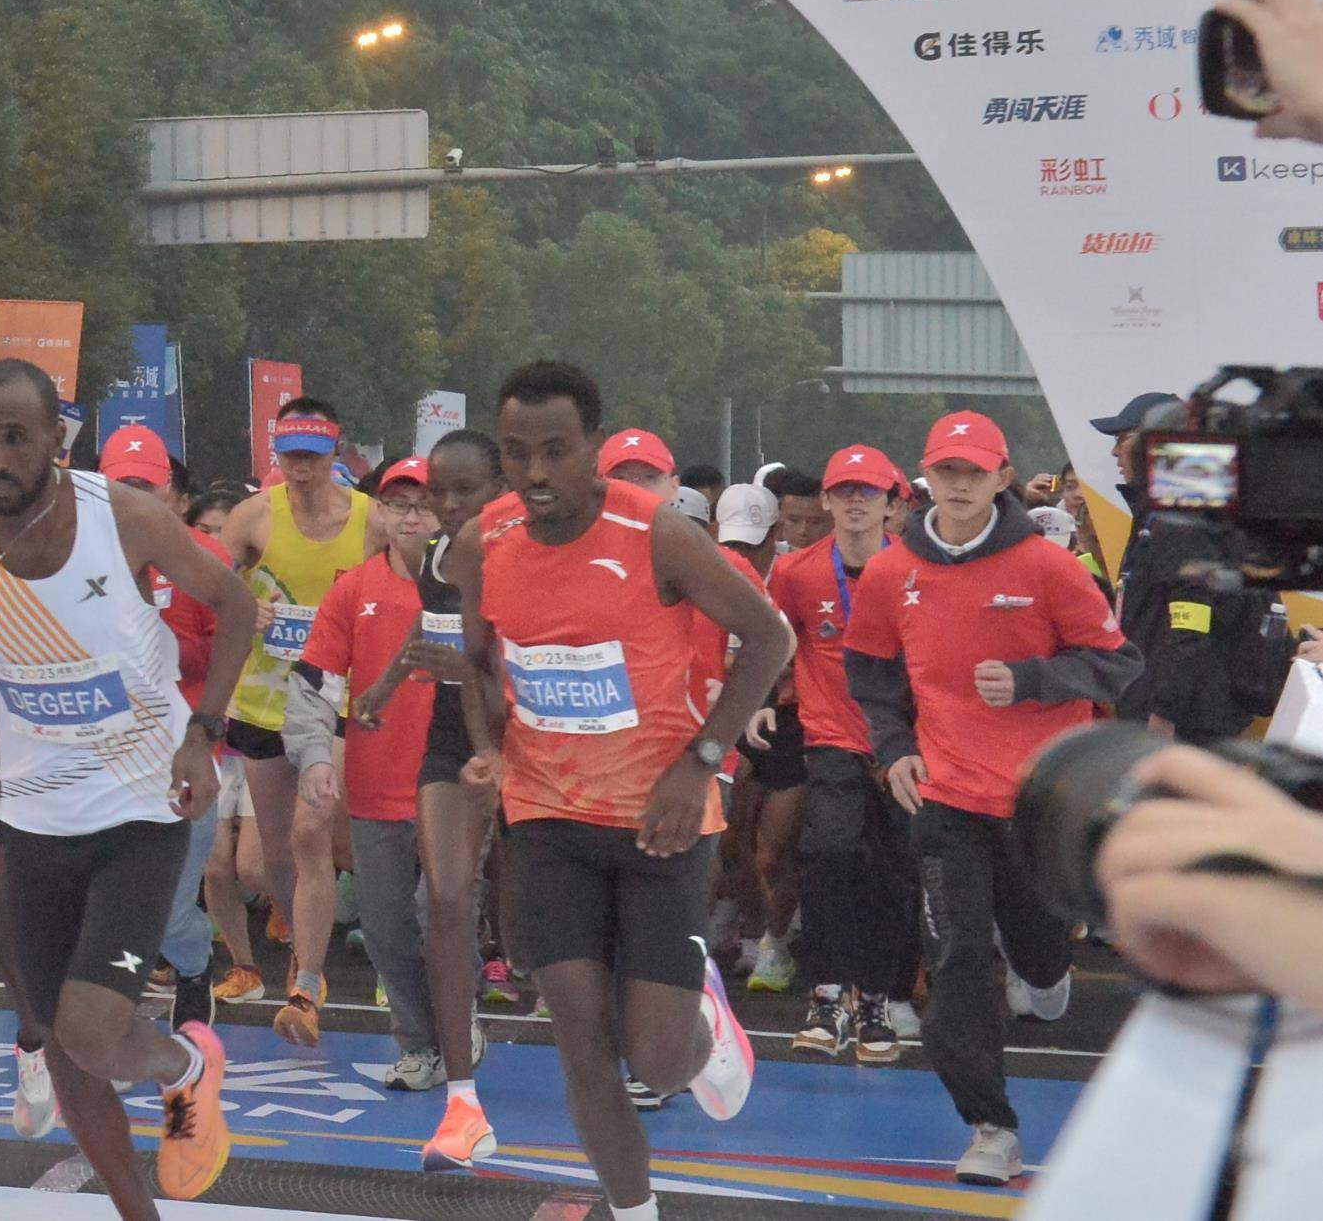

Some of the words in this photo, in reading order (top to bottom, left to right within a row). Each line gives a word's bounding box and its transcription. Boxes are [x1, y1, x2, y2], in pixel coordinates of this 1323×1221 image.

[948, 28, 1045, 59] 佳得乐
[982, 94, 1088, 125] 勇闯天涯
[1040, 158, 1107, 182] 彩虹
[1040, 184, 1107, 196] RAINBOW
[524, 652, 563, 666] 2023
[19, 667, 56, 679] 2023
[7, 687, 112, 716] DEGEFA
